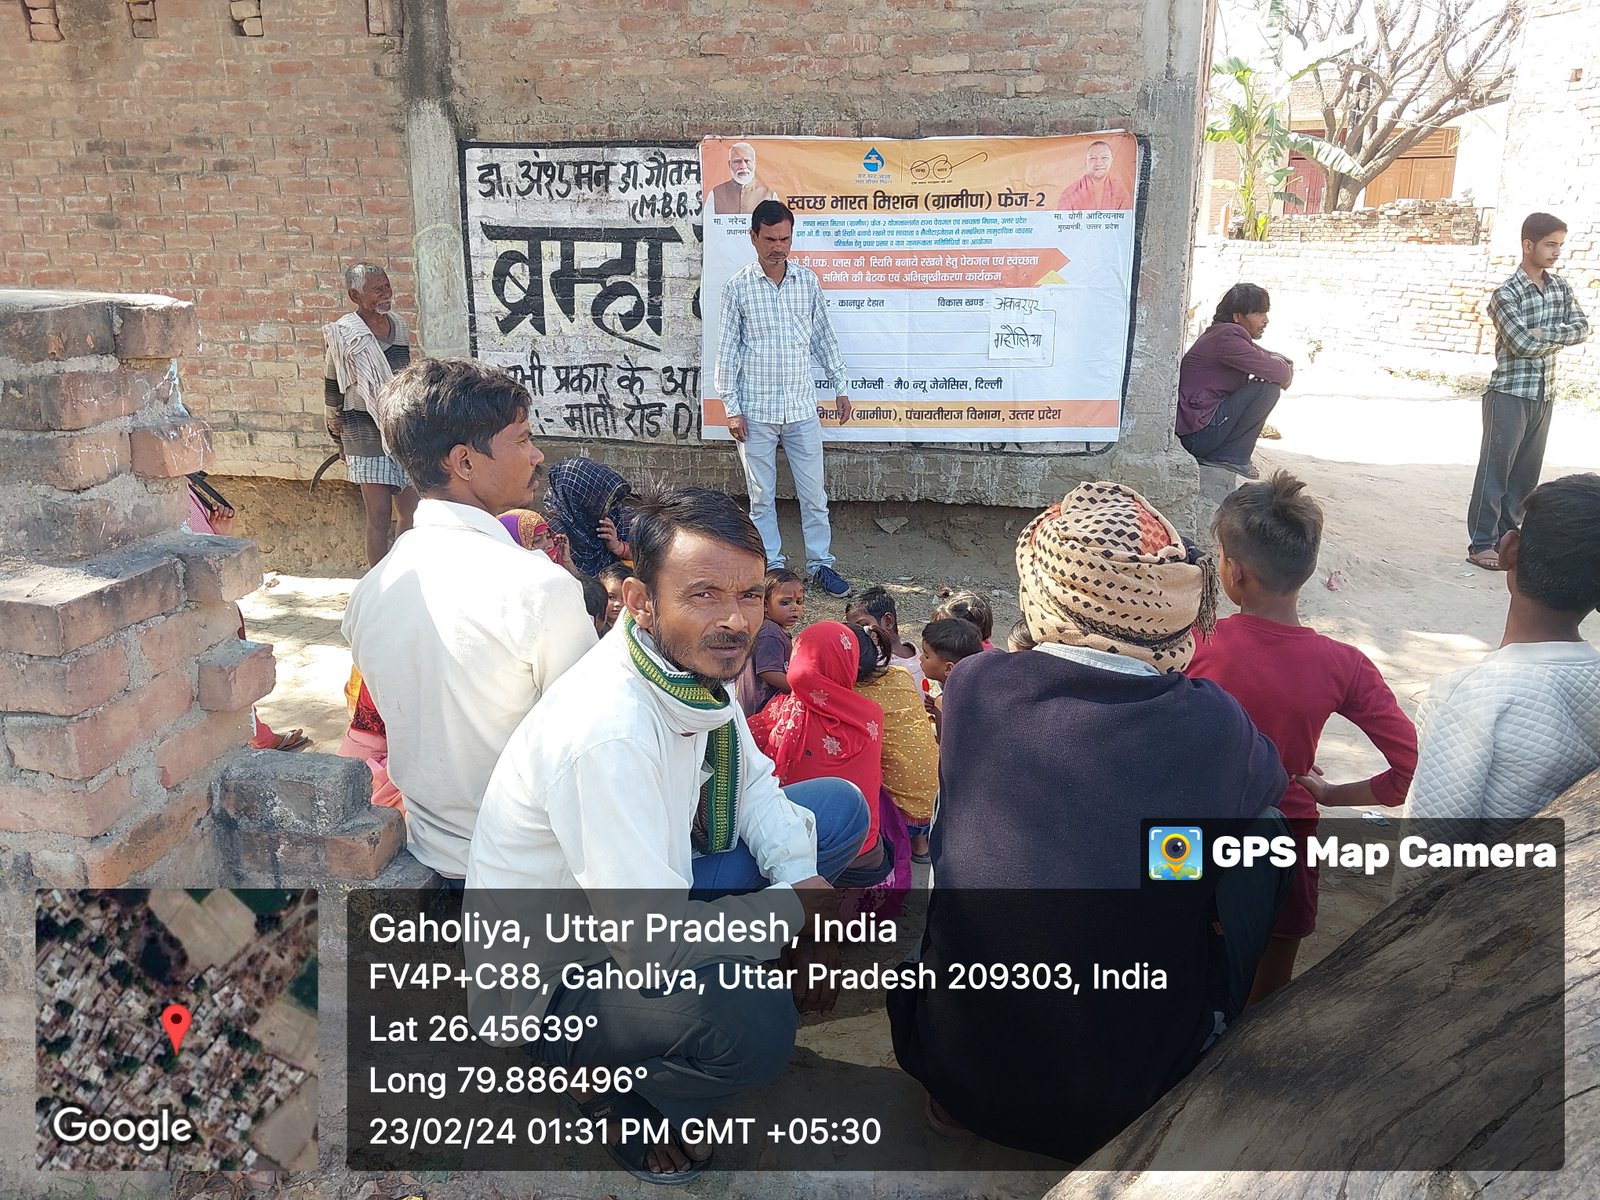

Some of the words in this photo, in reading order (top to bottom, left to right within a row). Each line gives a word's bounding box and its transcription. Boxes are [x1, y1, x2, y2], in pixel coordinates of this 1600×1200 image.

[787, 194, 826, 212] स्वच्छ
[831, 195, 868, 211] भारत
[873, 190, 919, 211] मिशन
[924, 188, 992, 210] (ग्रामीण)
[998, 187, 1046, 208] फेज-2
[713, 217, 724, 226] मा.
[1053, 213, 1064, 221] मा.
[1068, 211, 1083, 220] योगी
[1086, 211, 1125, 220] आदित्यनाथ
[726, 227, 750, 236] प्रधानमं
[1104, 222, 1120, 230] प्रदेश
[832, 258, 851, 268] प्लस
[853, 256, 866, 268] की
[870, 256, 893, 268] स्थिति
[895, 255, 918, 267] बनाये
[920, 255, 943, 267] रखने
[945, 254, 958, 269] हेतु
[960, 254, 990, 266] पेयजल
[992, 254, 1005, 266] एवं
[1007, 256, 1039, 266] स्वच्छता
[822, 271, 849, 283] समिति
[851, 271, 863, 283] की
[888, 272, 900, 283] एवं
[838, 299, 864, 310] कानपुर
[867, 297, 885, 308] देहात
[937, 296, 963, 307] विकास
[964, 298, 984, 307] खण्ड
[553, 363, 612, 398] प्रकार
[617, 354, 654, 397] के
[851, 377, 884, 390] एजेन्सी
[912, 379, 928, 393] न्यू
[929, 377, 972, 392] जेनेसिस,
[975, 376, 1003, 390] दिल्ली
[623, 396, 668, 438] रोड
[851, 406, 902, 422] (ग्रामीण),
[905, 407, 963, 421] पंचायतीराज
[966, 406, 1005, 422] विभाग,
[1008, 409, 1035, 421] उत्तर
[1038, 406, 1061, 421] प्रदेश
